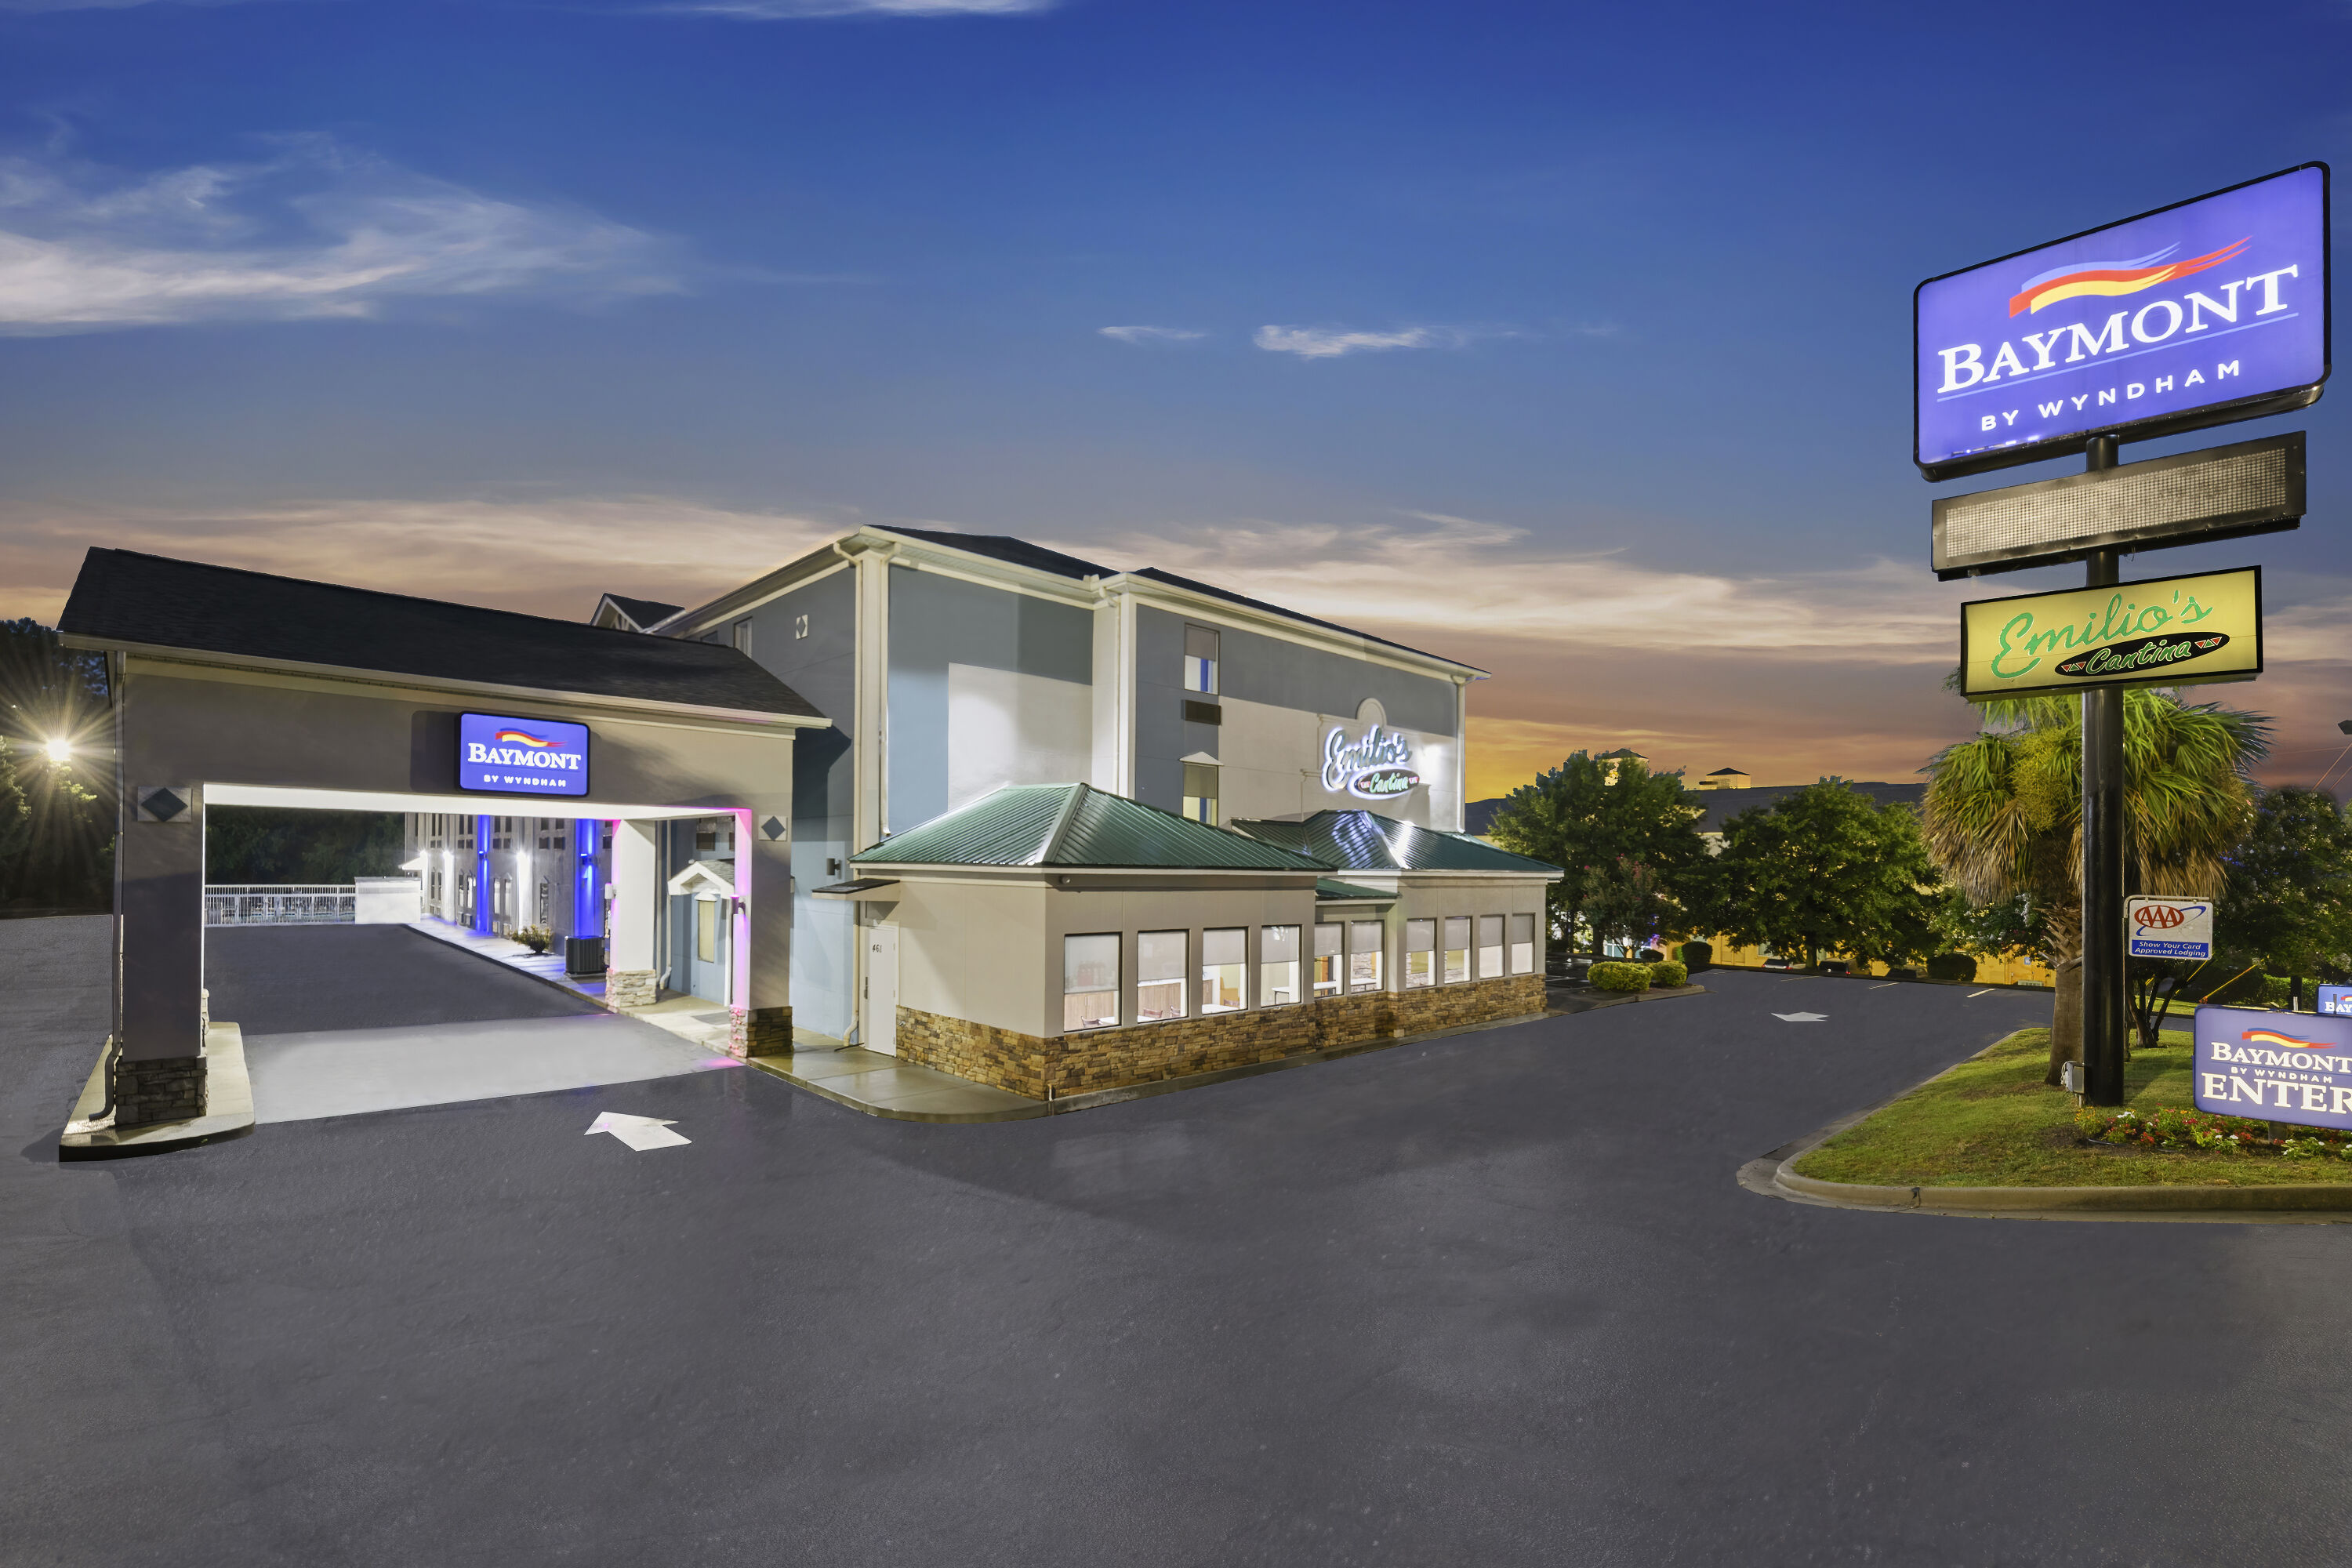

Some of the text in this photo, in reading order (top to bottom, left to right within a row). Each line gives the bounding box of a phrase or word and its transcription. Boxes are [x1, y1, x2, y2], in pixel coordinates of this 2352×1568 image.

[1937, 264, 2298, 394] BAYMONT
[1981, 360, 2240, 432] BY WYNDHAM
[1991, 590, 2212, 679] Emilio's
[2085, 640, 2192, 674] Cantina
[468, 742, 581, 770] BAYMONT
[1323, 725, 1413, 791] Emilio's
[484, 774, 566, 787] BY WYNDHAM
[1370, 773, 1409, 793] Cantina
[2139, 906, 2180, 929] AAA
[2211, 1042, 2352, 1073] BAYMONT
[2255, 1069, 2332, 1083] WYNDHAM
[2201, 1073, 2352, 1114] ENTER
